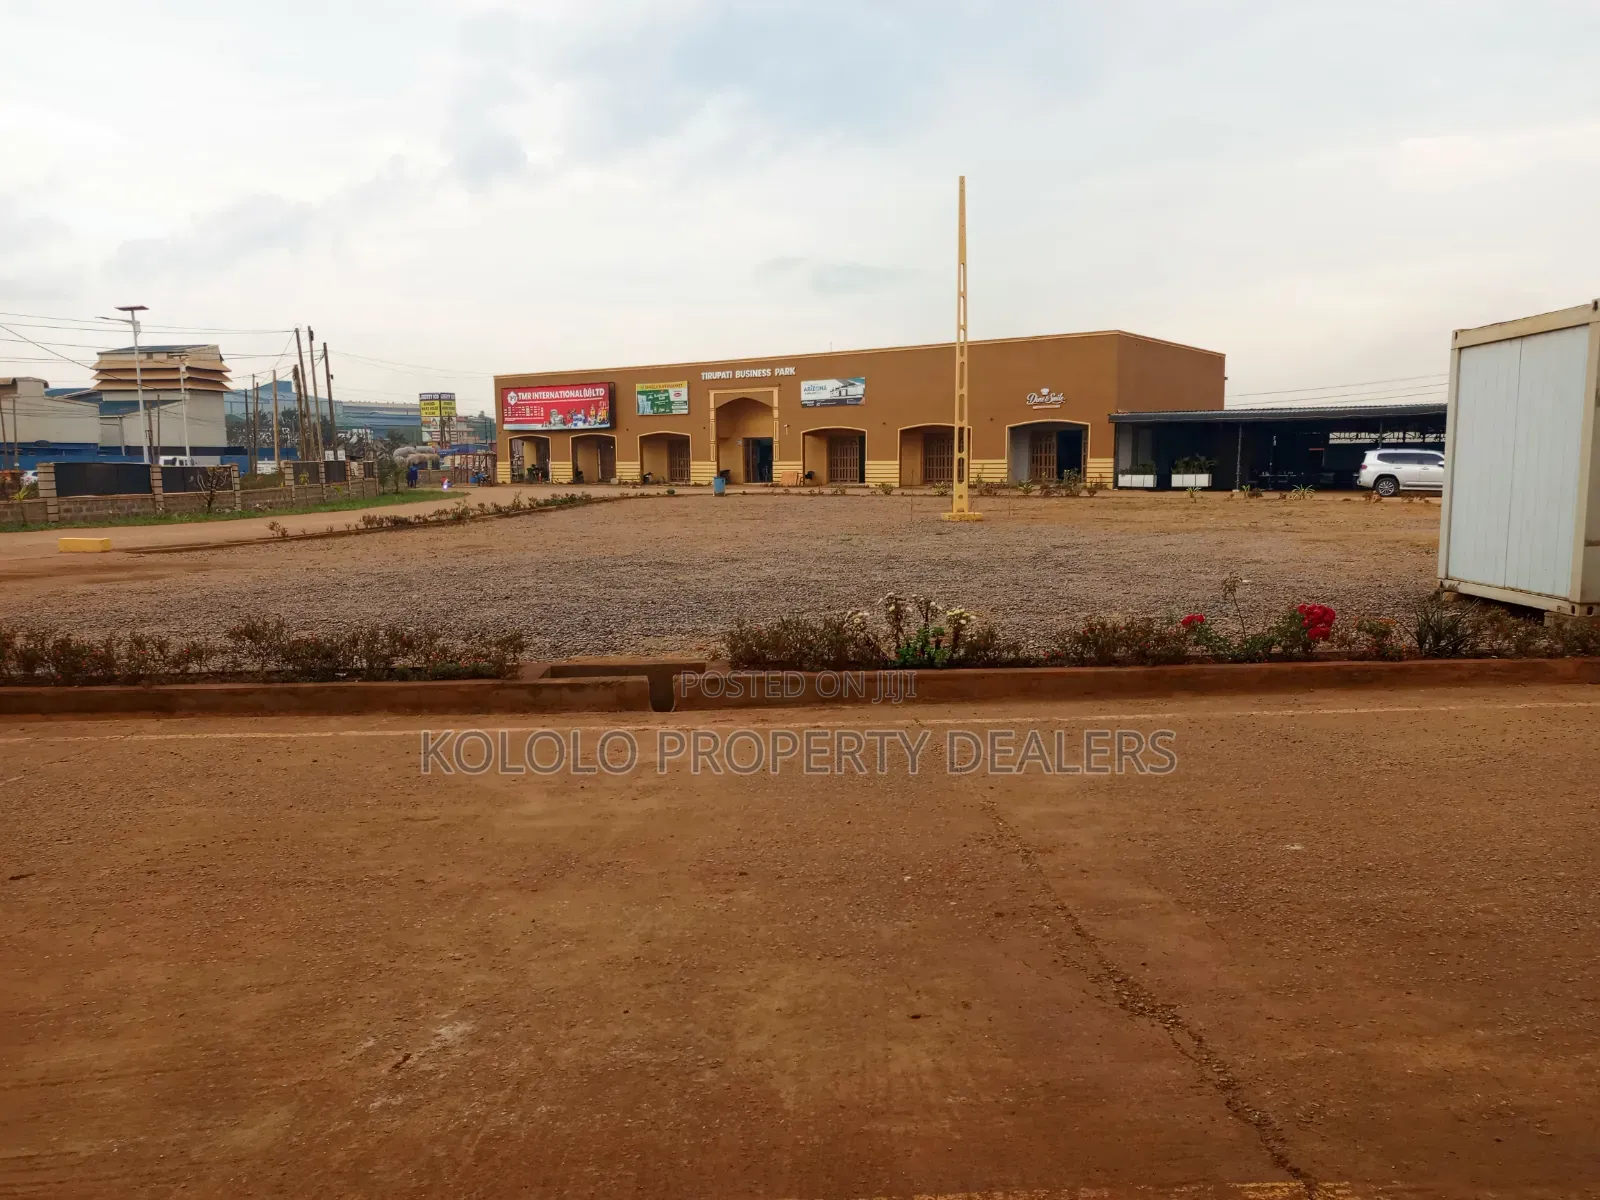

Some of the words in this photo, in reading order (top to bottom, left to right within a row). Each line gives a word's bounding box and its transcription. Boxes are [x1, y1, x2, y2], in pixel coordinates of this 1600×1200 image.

[701, 371, 732, 380] TIRUPATI
[735, 369, 771, 379] BUSINESS
[774, 367, 796, 376] PARK
[518, 392, 532, 400] TMR
[532, 389, 583, 400] INTERNATIONAL
